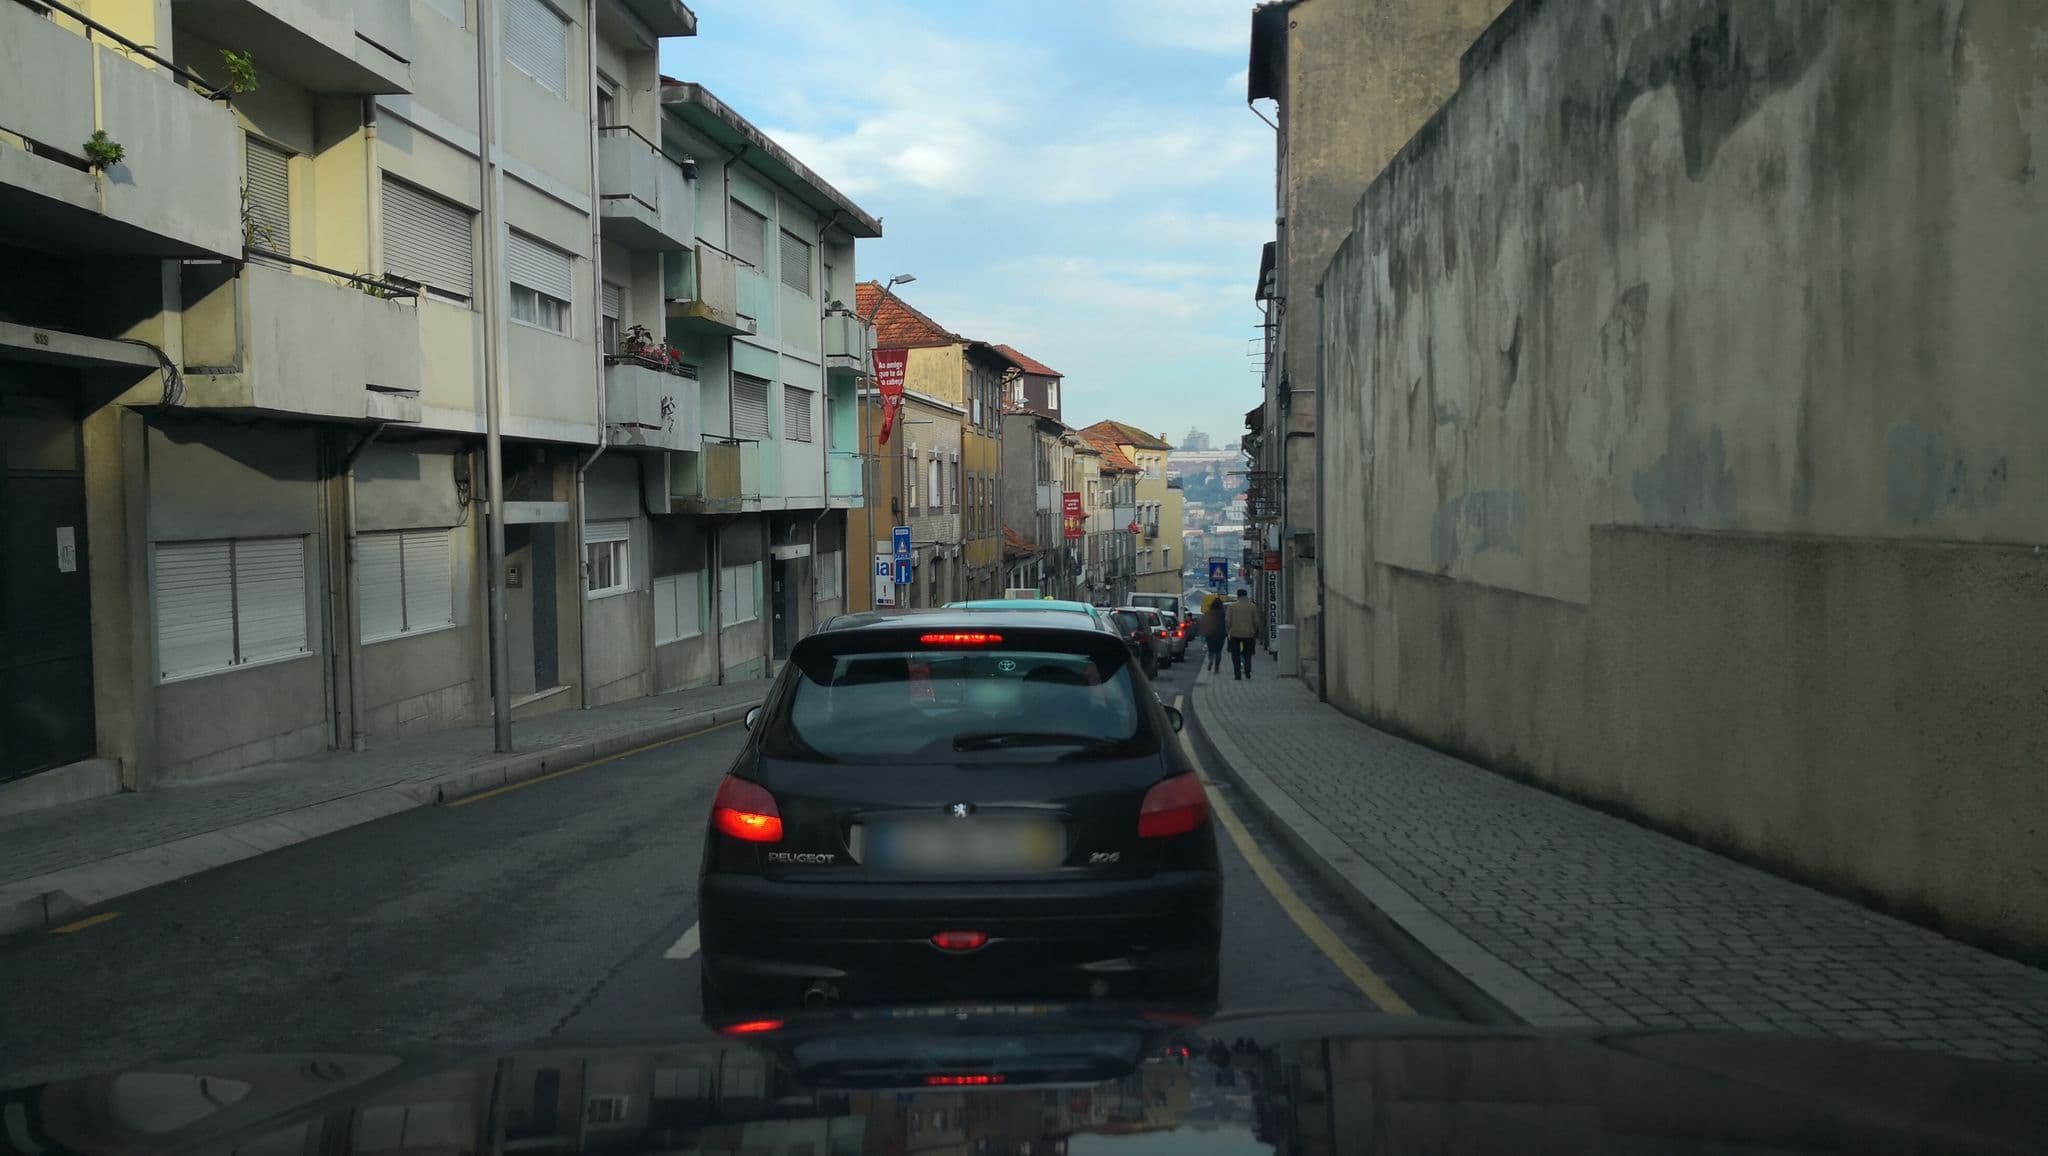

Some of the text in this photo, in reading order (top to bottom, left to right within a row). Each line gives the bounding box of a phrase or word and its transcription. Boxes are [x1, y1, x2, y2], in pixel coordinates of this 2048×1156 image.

[887, 361, 903, 370] amigo
[768, 852, 835, 864] PEUGEOT
[1089, 851, 1121, 864] 206
